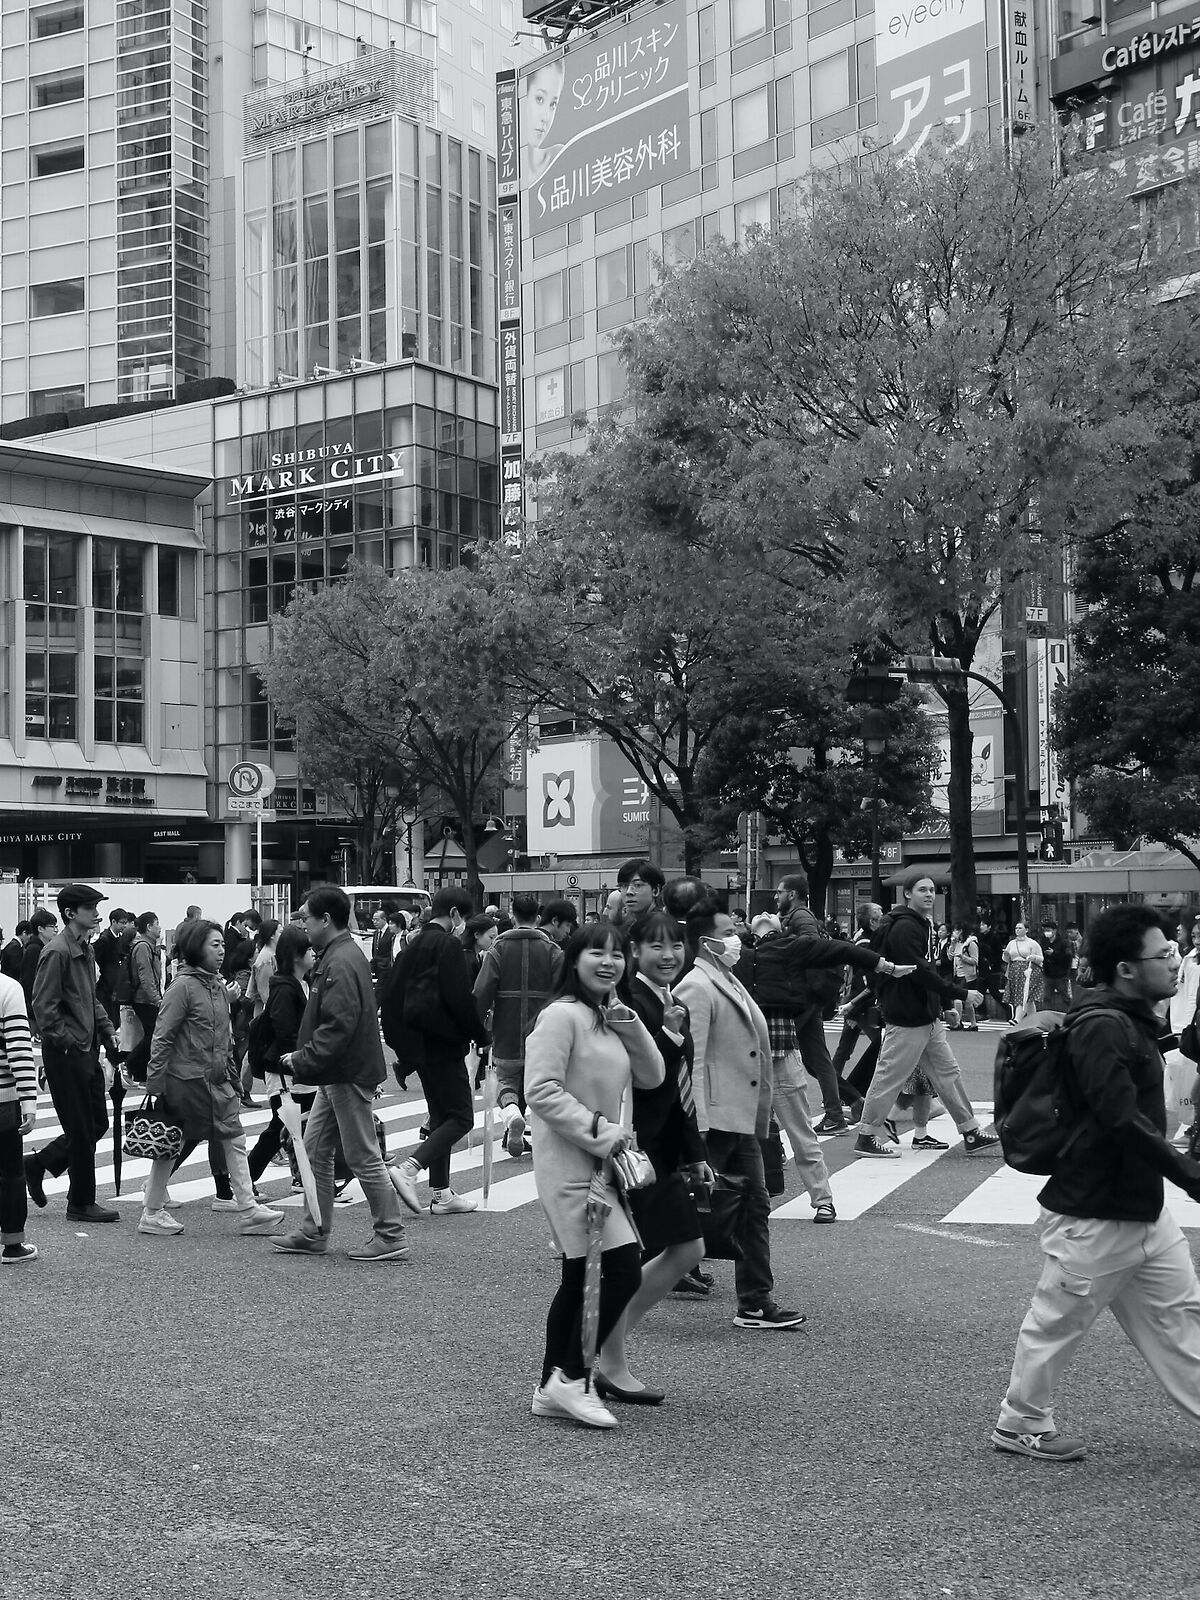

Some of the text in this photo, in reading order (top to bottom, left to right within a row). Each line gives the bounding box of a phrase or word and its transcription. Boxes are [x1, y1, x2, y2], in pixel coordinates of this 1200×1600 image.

[594, 22, 679, 84] 品川スキン
[1013, 10, 1028, 103] 献血ルーム
[594, 56, 670, 112] クリニック
[251, 79, 383, 132] MARK CITY
[1117, 88, 1168, 128] Café
[500, 97, 514, 178] 東急リバブル
[502, 184, 514, 192] 9F
[550, 124, 681, 212] 品川美容外科
[503, 222, 515, 306] 東京スター銀行
[504, 310, 515, 318] 8F
[504, 330, 517, 387] 外貨両替
[271, 442, 354, 466] SHIBUYA
[505, 434, 518, 442] 7F
[229, 452, 405, 497] MARK CITY
[1030, 609, 1043, 619] 7F
[230, 801, 260, 809] ここまで
[25, 834, 54, 842] MARK
[57, 832, 83, 841] CITY
[887, 847, 898, 858] 8F
